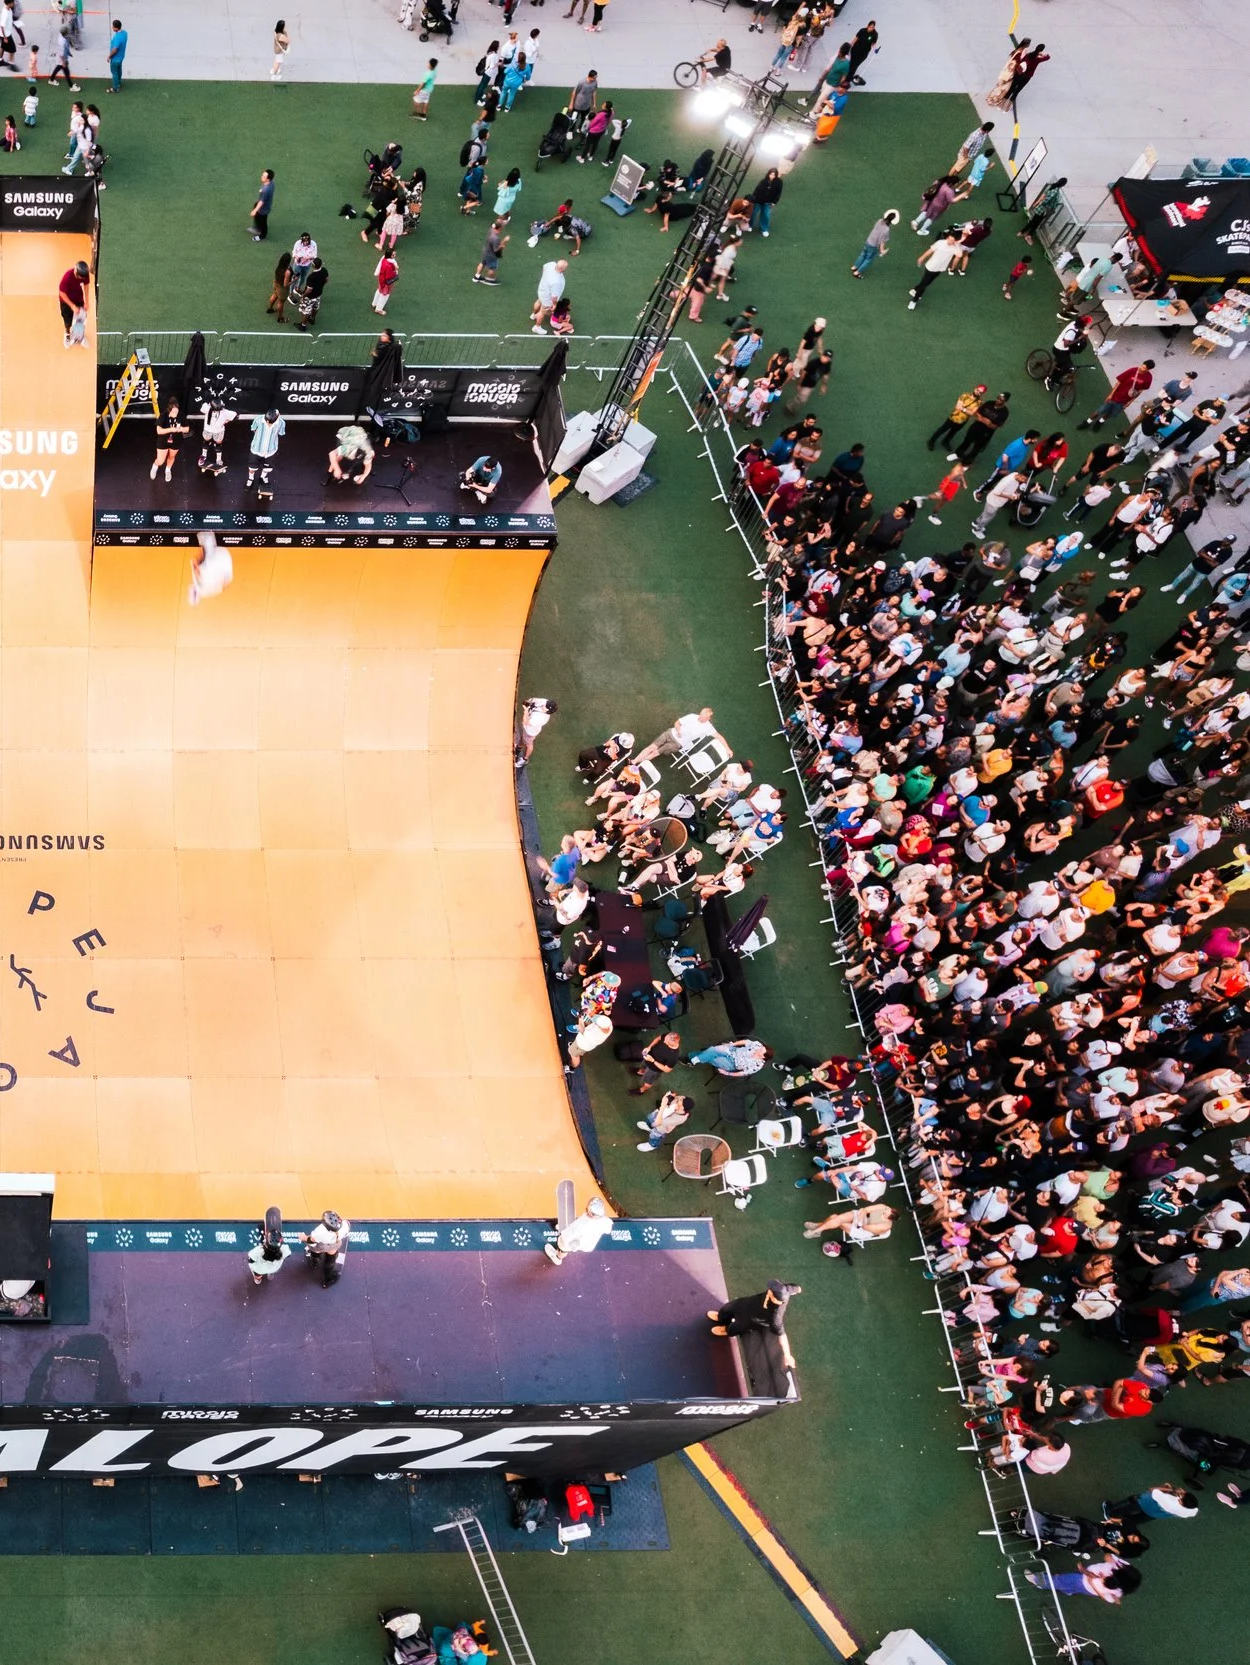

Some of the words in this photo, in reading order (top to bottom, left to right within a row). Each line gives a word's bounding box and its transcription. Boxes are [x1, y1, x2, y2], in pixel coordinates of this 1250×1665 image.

[4, 192, 74, 204] SAMSUNG
[13, 205, 64, 220] Galaxy
[280, 381, 350, 392] SAMSUNG
[287, 393, 337, 404] Galaxy
[414, 1408, 514, 1416] SAMSUNG
